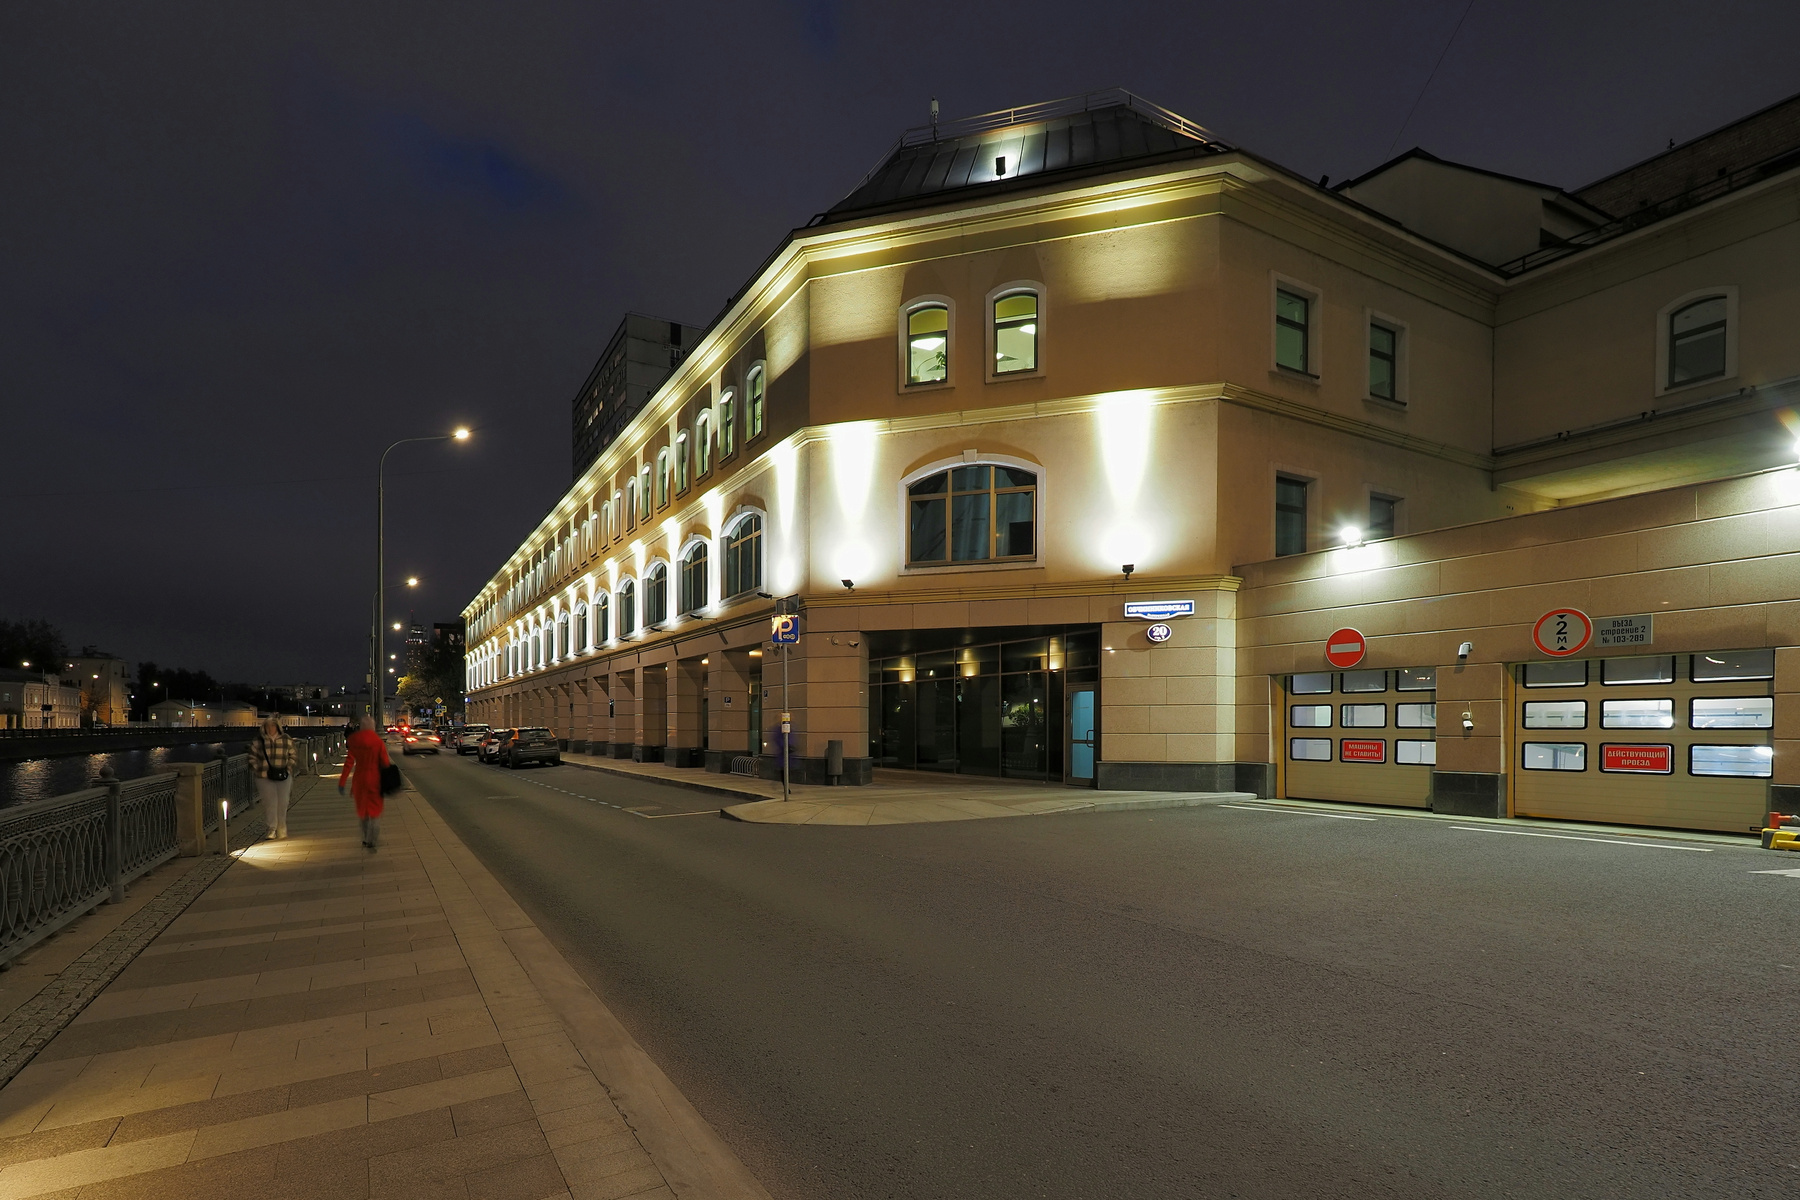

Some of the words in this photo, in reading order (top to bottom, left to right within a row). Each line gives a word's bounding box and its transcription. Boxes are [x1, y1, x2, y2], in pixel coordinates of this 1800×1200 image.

[1152, 626, 1167, 635] 20
[1556, 621, 1568, 635] 2
[1601, 627, 1639, 635] строение
[1613, 634, 1644, 643] 103-289
[1608, 750, 1666, 758] ДЕЙСТВУЮЩИЙ
